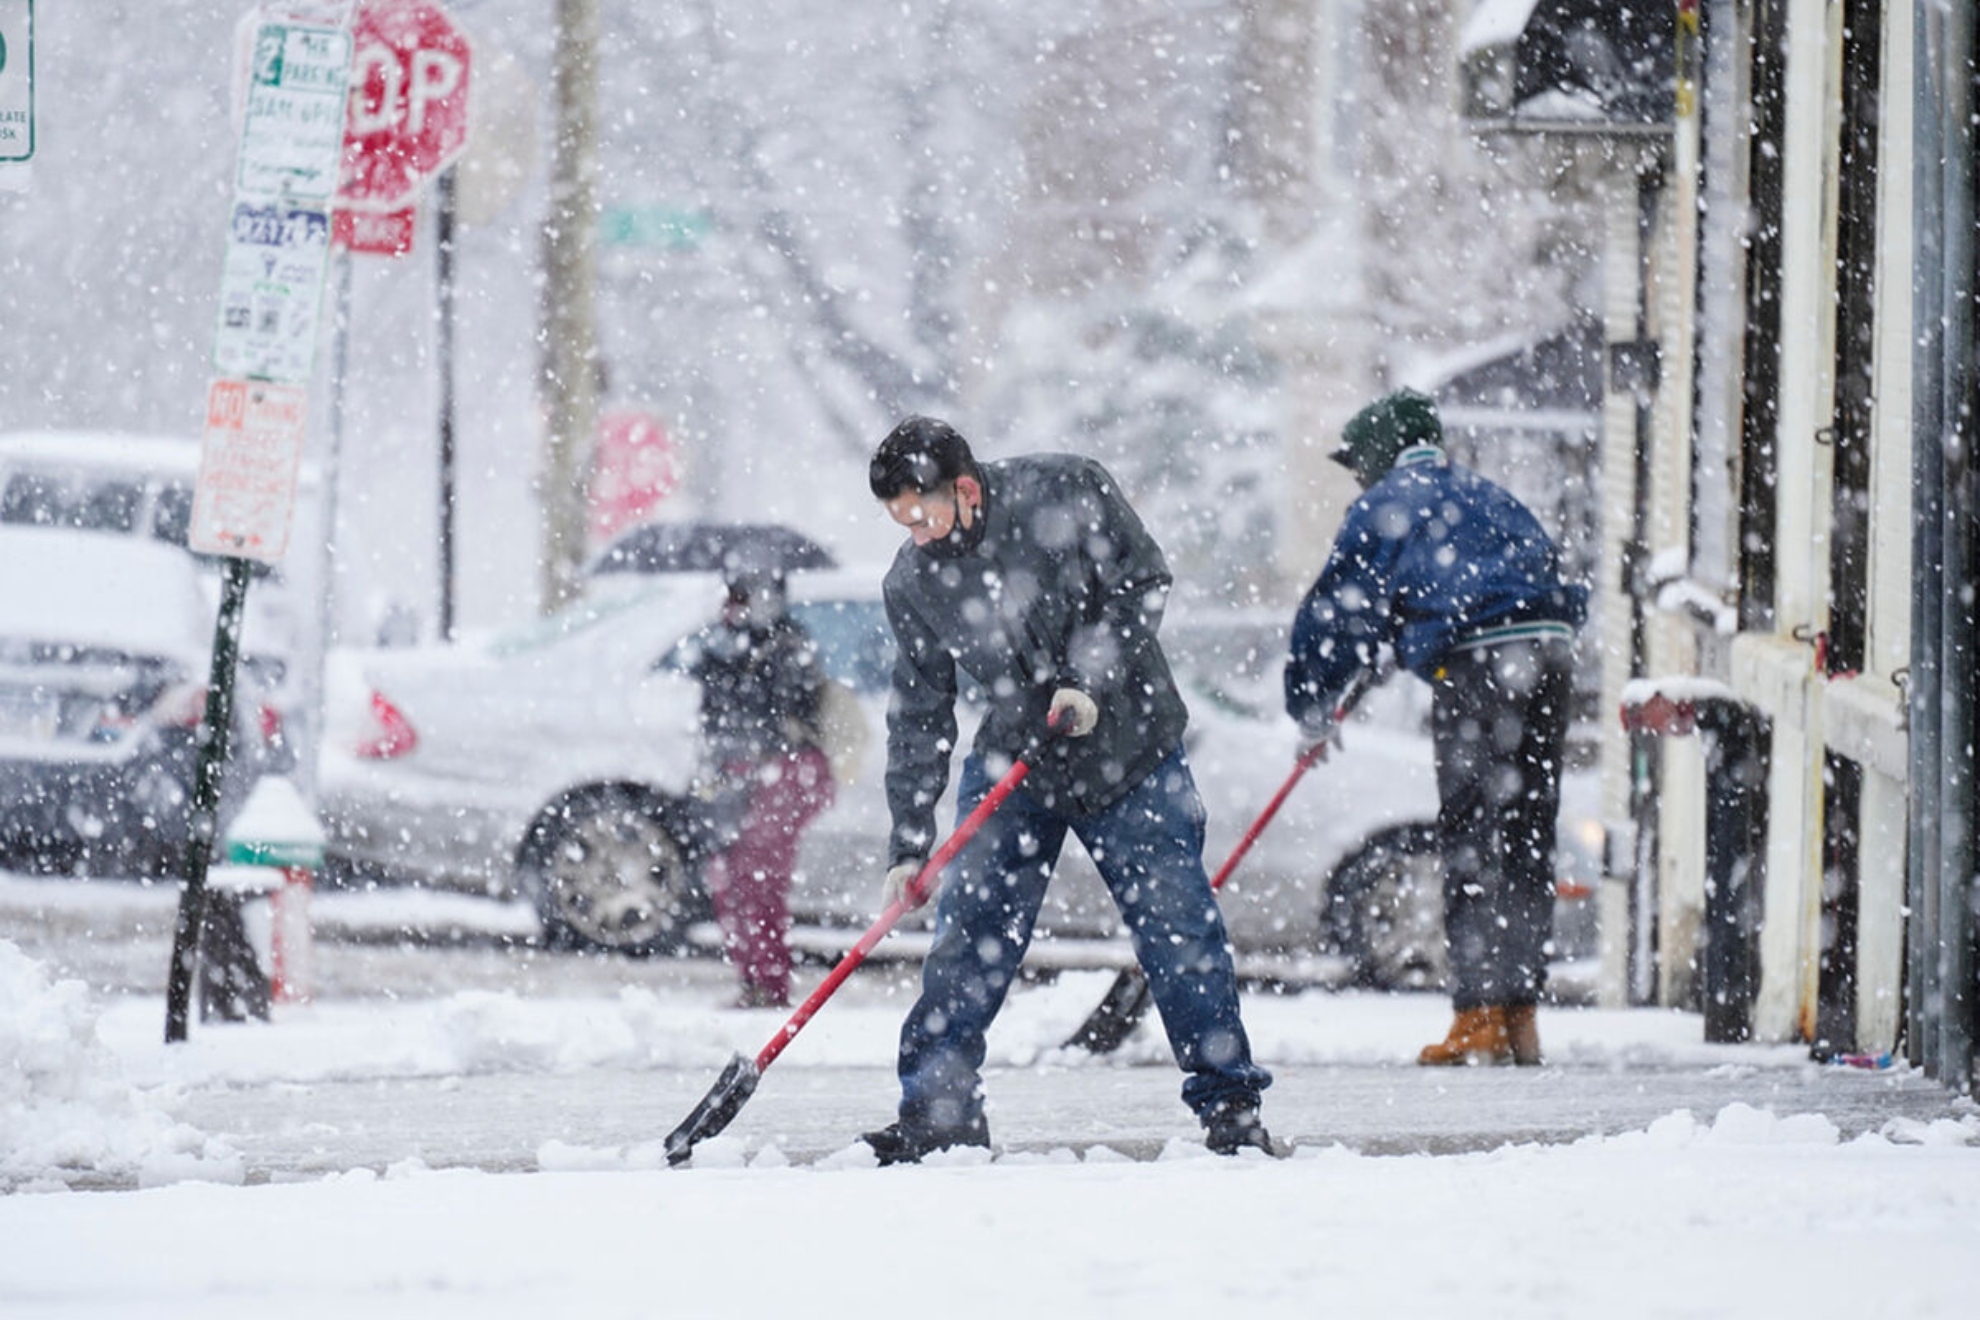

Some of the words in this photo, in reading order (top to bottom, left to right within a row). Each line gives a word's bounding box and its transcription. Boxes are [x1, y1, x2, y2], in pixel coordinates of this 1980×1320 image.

[285, 62, 347, 86] PARKNG
[349, 41, 463, 136] OP
[0, 111, 26, 123] LATE
